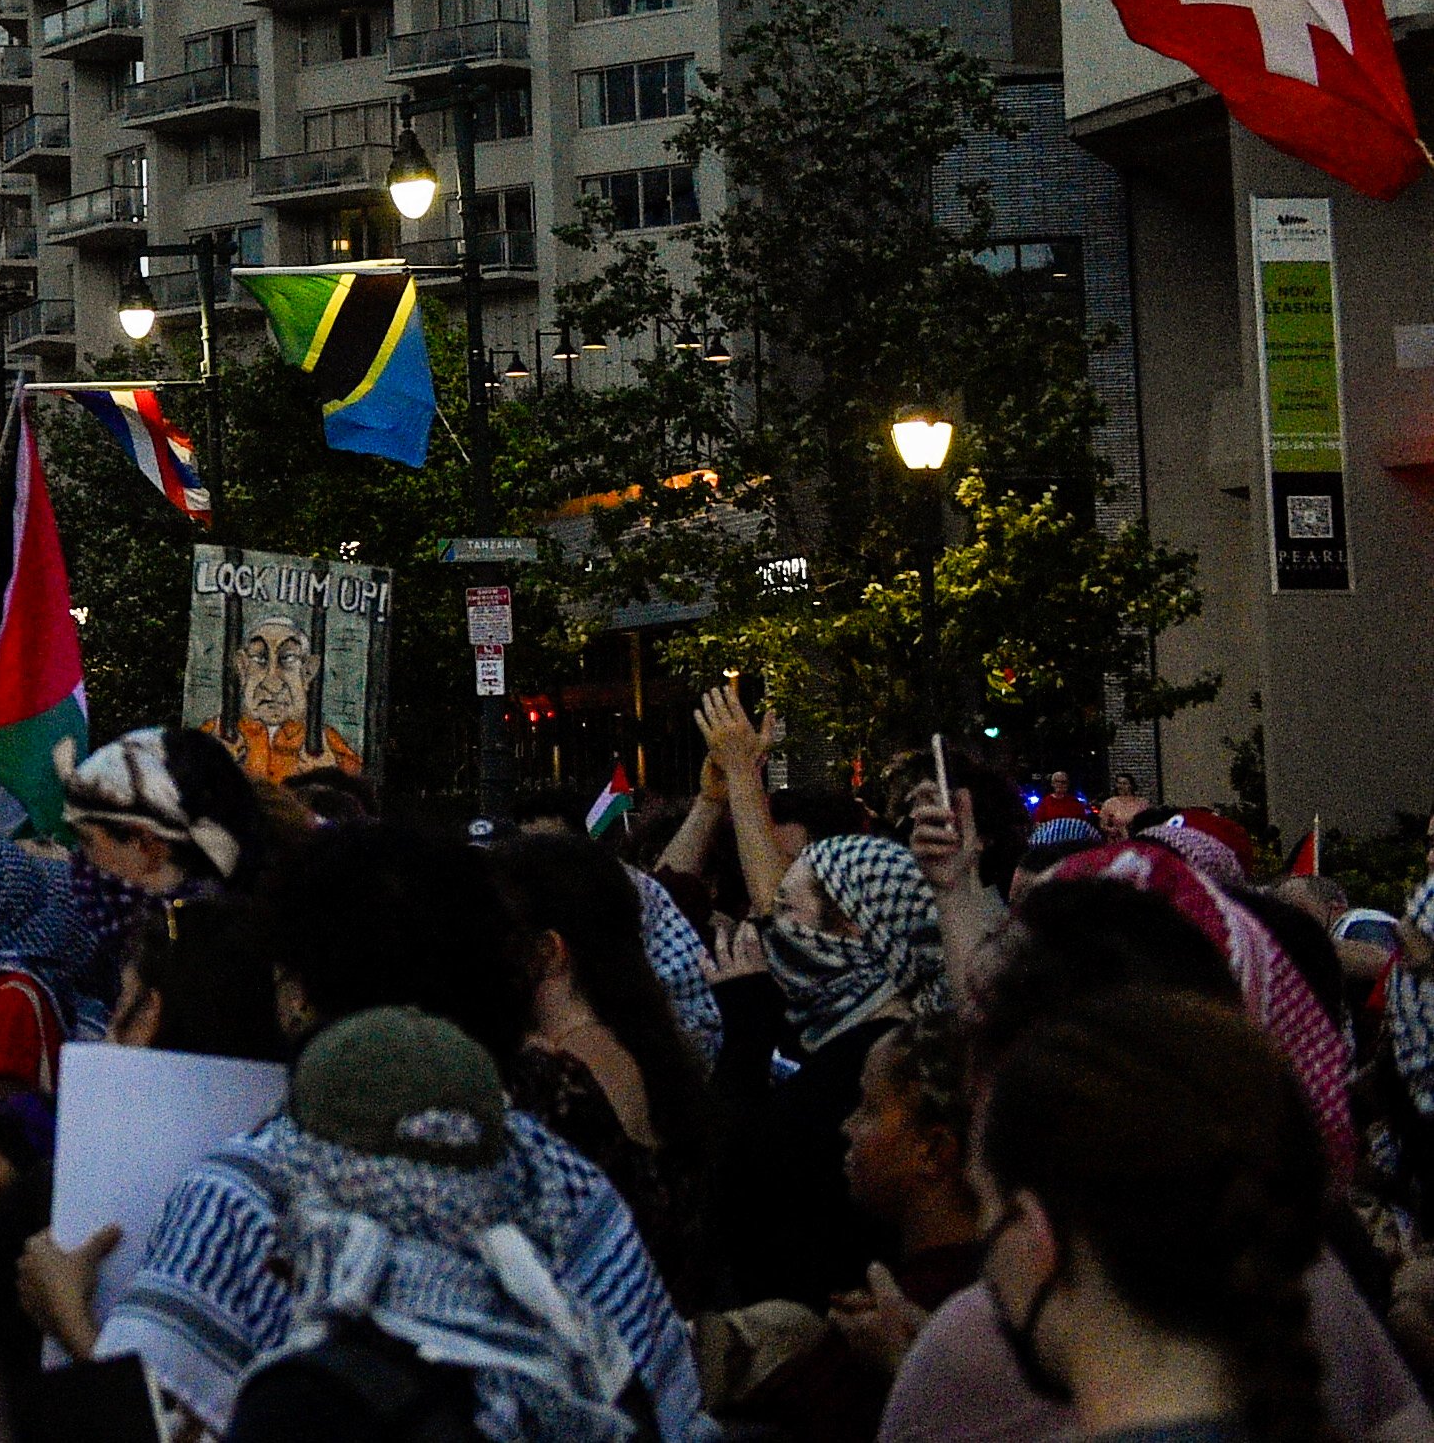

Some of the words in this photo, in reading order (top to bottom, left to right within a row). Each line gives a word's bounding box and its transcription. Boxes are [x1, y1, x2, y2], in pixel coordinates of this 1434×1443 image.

[1278, 286, 1317, 297] NOW
[1264, 302, 1332, 314] LEASING
[467, 540, 522, 549] TANZANIA
[1278, 549, 1347, 564] PEARL
[195, 561, 269, 602] LOCK
[277, 567, 331, 609] HIM
[337, 577, 389, 623] UP!
